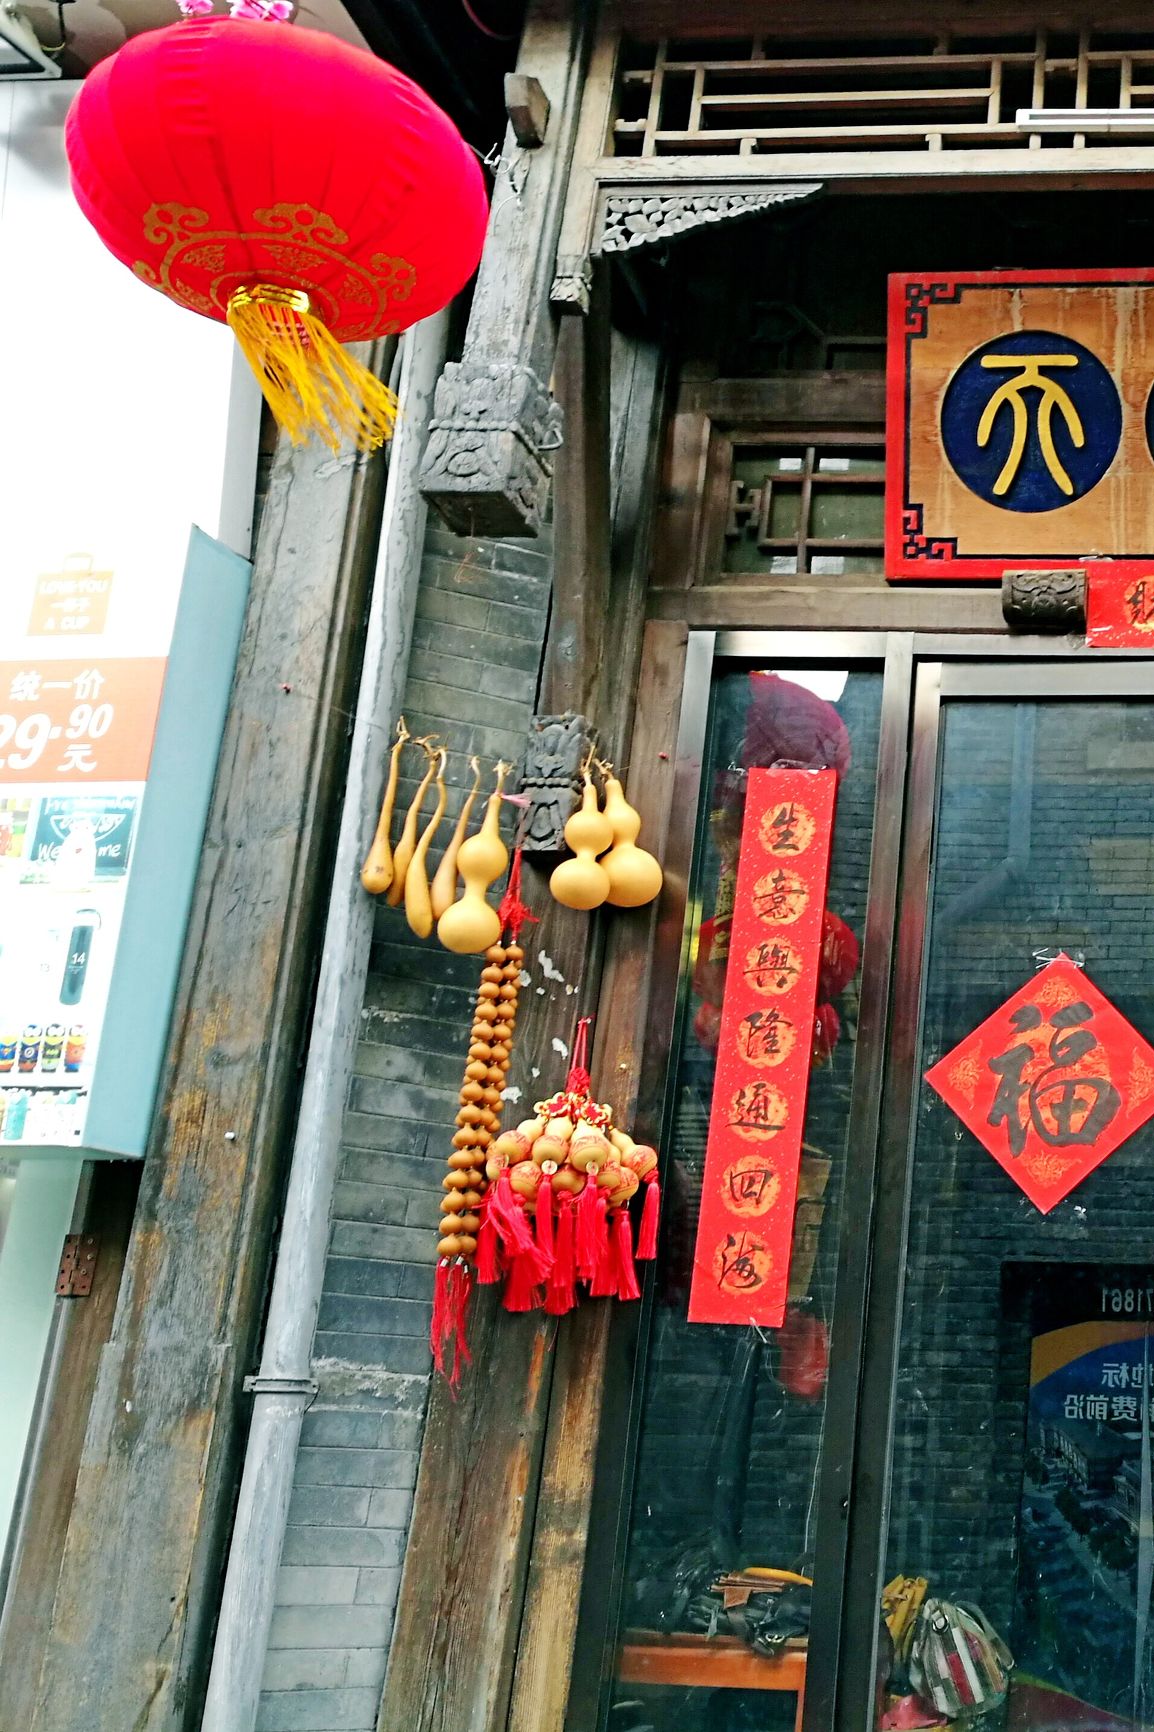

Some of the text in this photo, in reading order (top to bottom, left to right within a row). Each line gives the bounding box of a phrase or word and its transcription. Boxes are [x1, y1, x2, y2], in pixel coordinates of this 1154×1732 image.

[9, 668, 105, 700] 统一价
[57, 743, 97, 772] 元
[72, 952, 86, 964] 14
[987, 1001, 1126, 1158] 福
